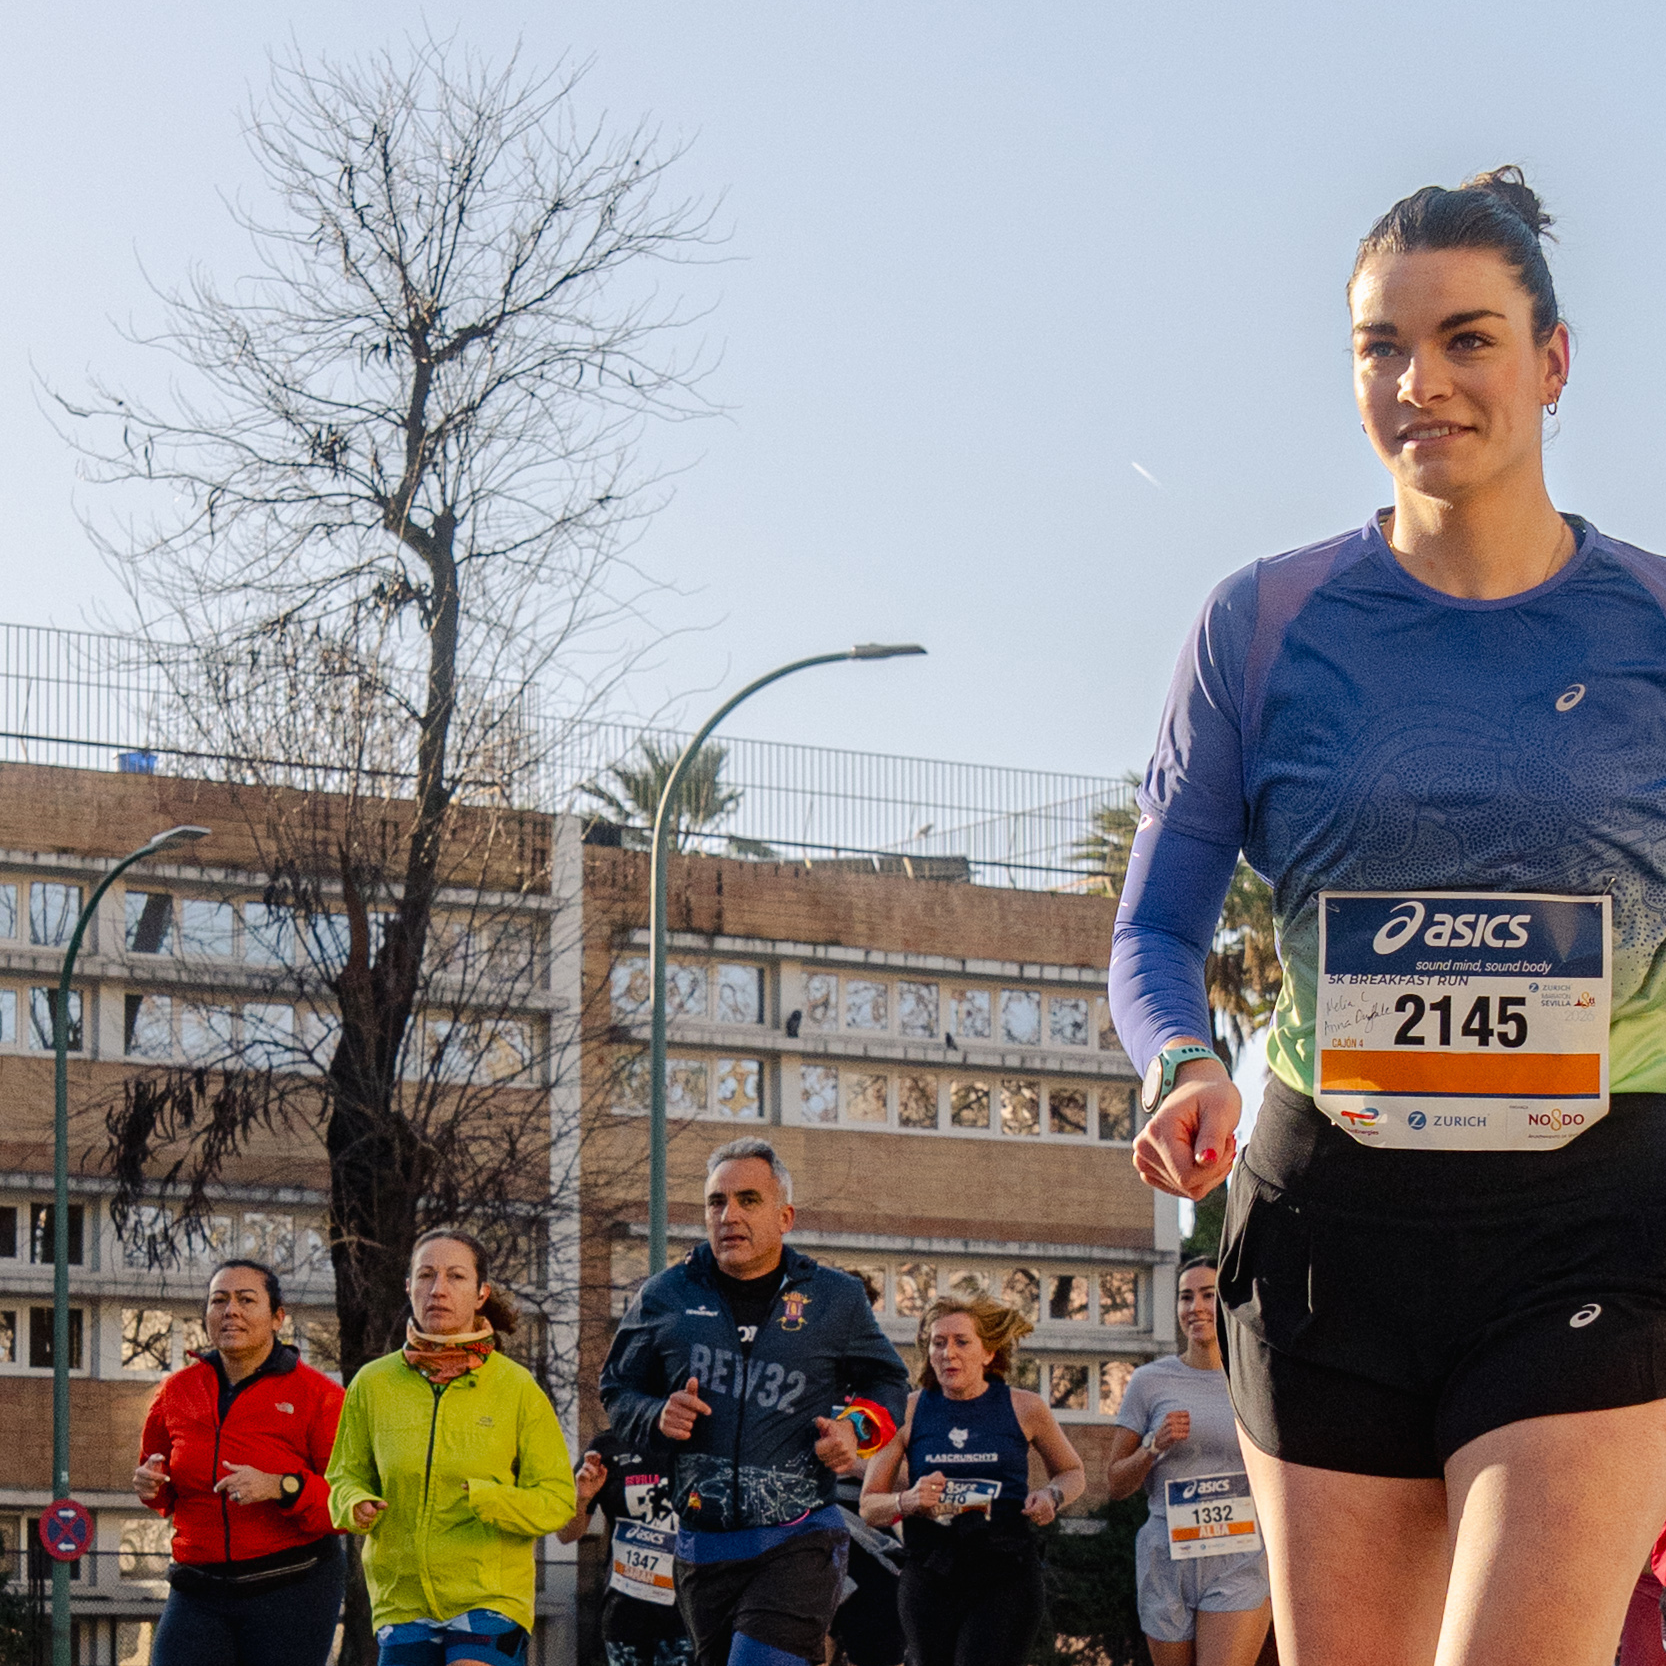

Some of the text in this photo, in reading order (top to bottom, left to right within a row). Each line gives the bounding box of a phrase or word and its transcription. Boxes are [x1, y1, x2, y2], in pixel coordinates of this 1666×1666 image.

[1415, 959, 1553, 975] sound mind, sound body
[1328, 974, 1469, 987] 5K BREAKFAST RUN
[1393, 993, 1528, 1048] 2145
[1564, 1010, 1595, 1022] 2026
[1332, 1036, 1364, 1048] CAJÓN 4
[1433, 1115, 1487, 1127] ZURICH
[1192, 1504, 1234, 1525] 1332
[626, 1549, 660, 1571] 1347
